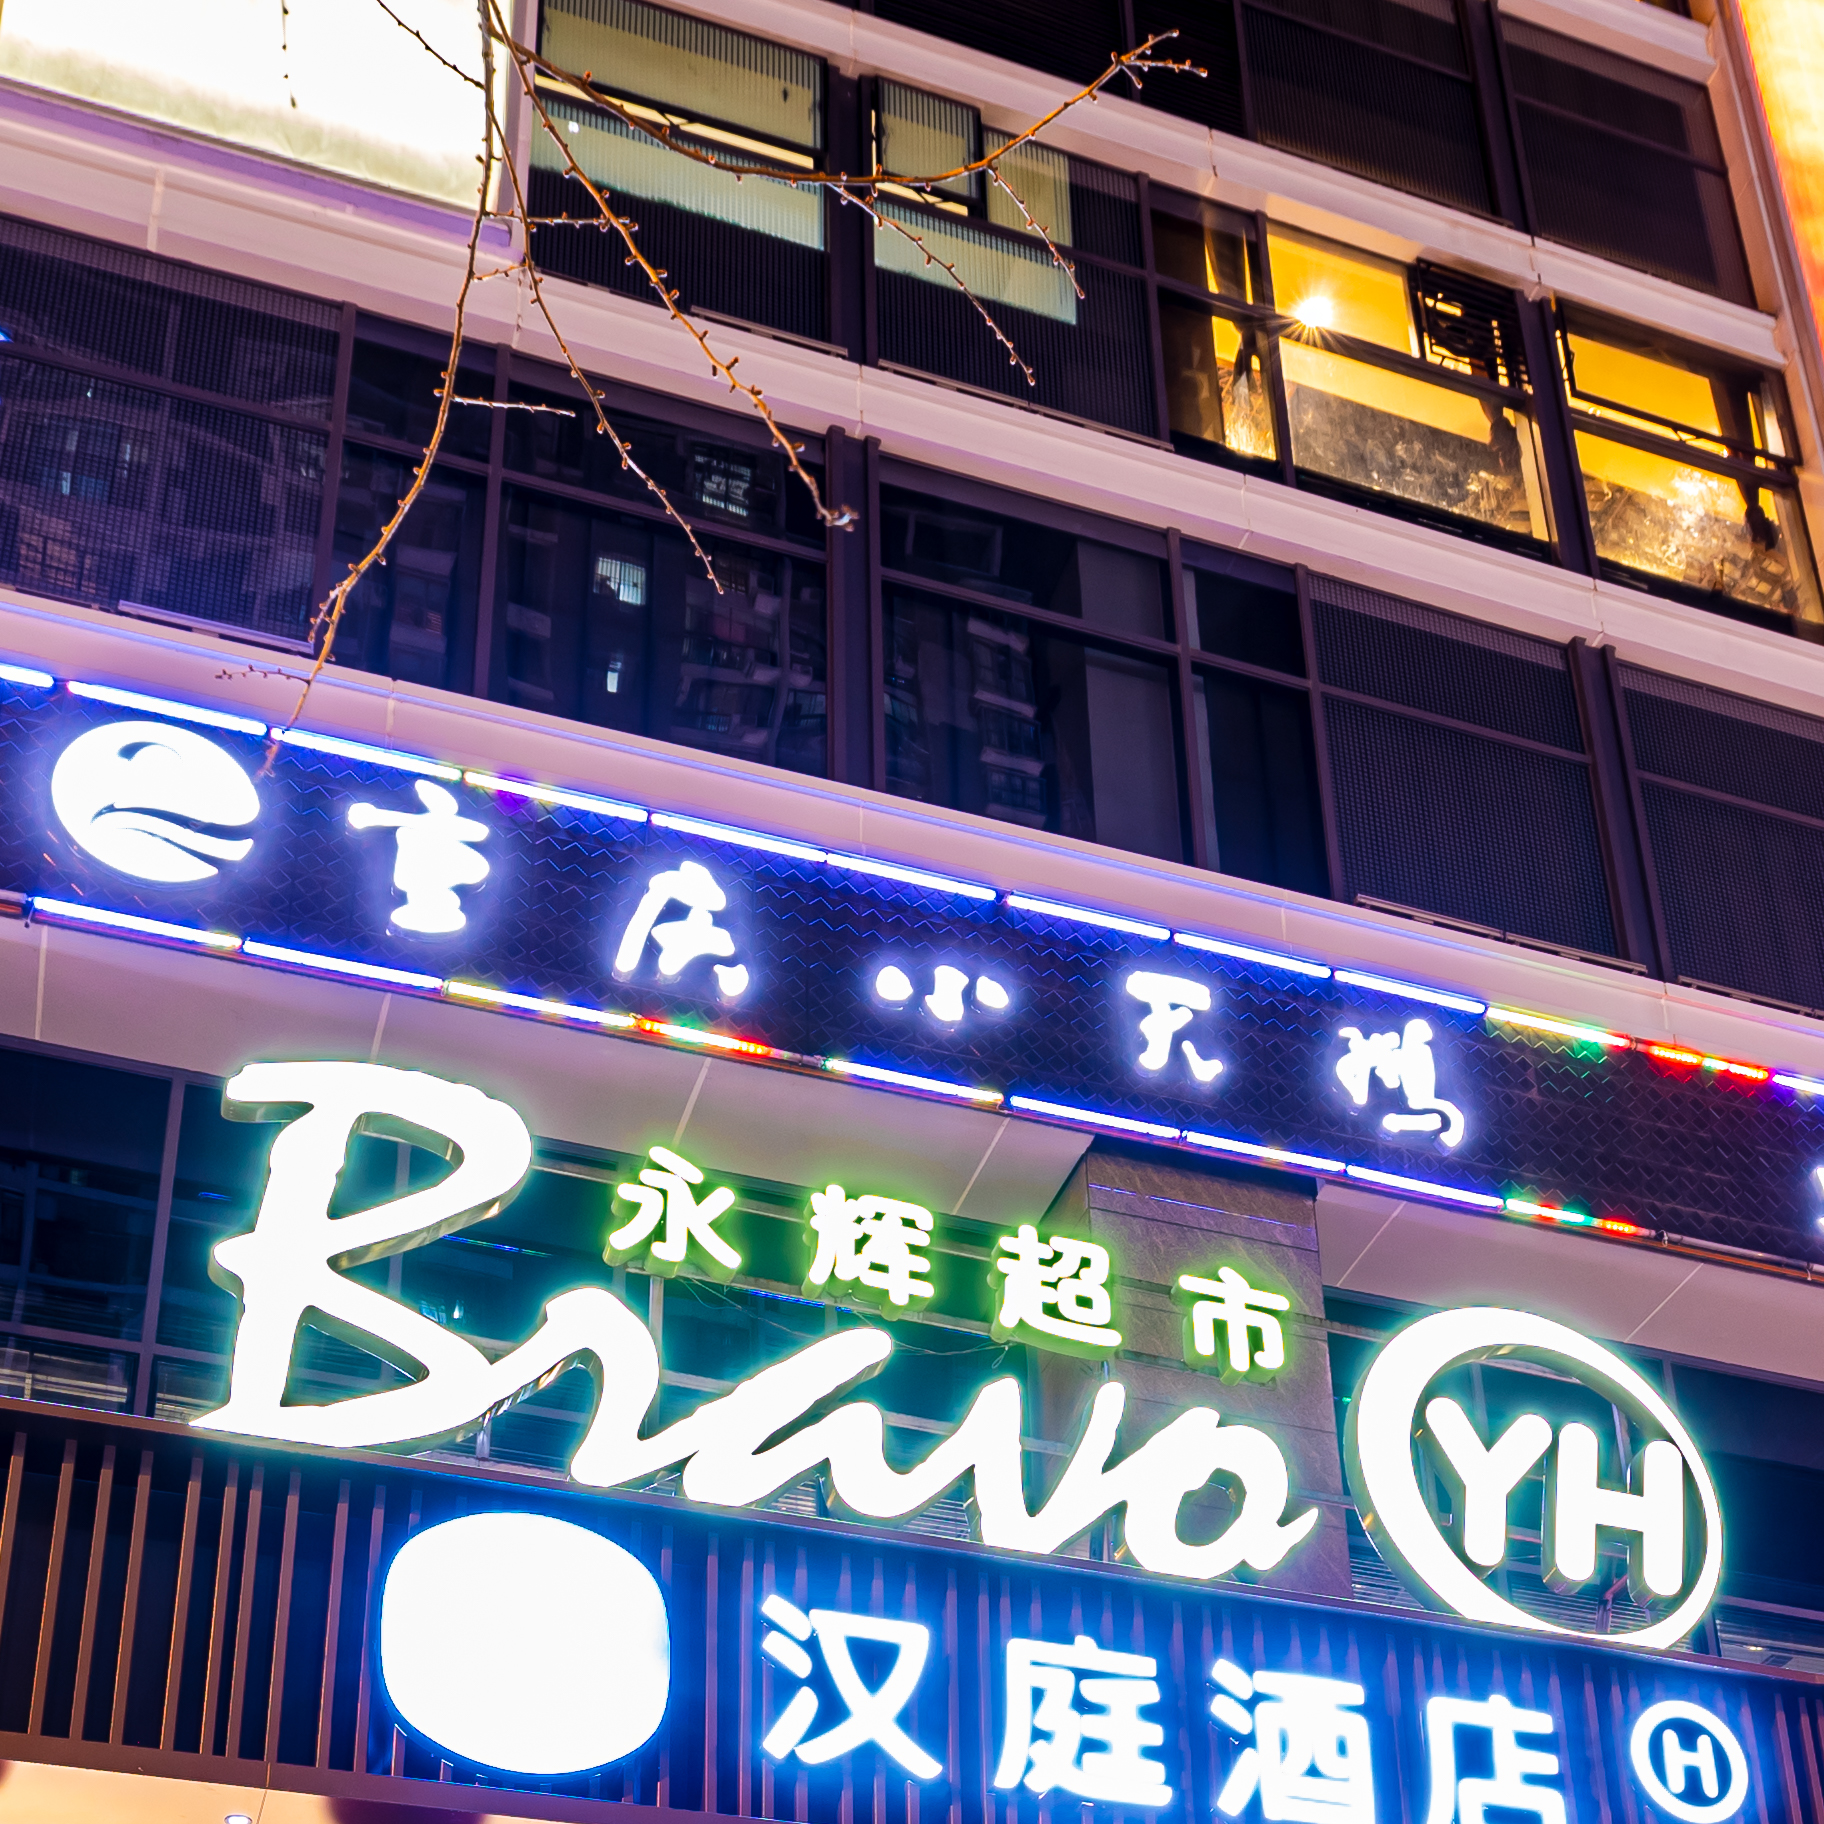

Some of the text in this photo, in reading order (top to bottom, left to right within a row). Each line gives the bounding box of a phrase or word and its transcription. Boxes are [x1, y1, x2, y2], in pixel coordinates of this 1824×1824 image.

[188, 1060, 1318, 1579] Bravo
[606, 1146, 1292, 1386] 永辉超市
[1422, 1396, 1686, 1598] YH
